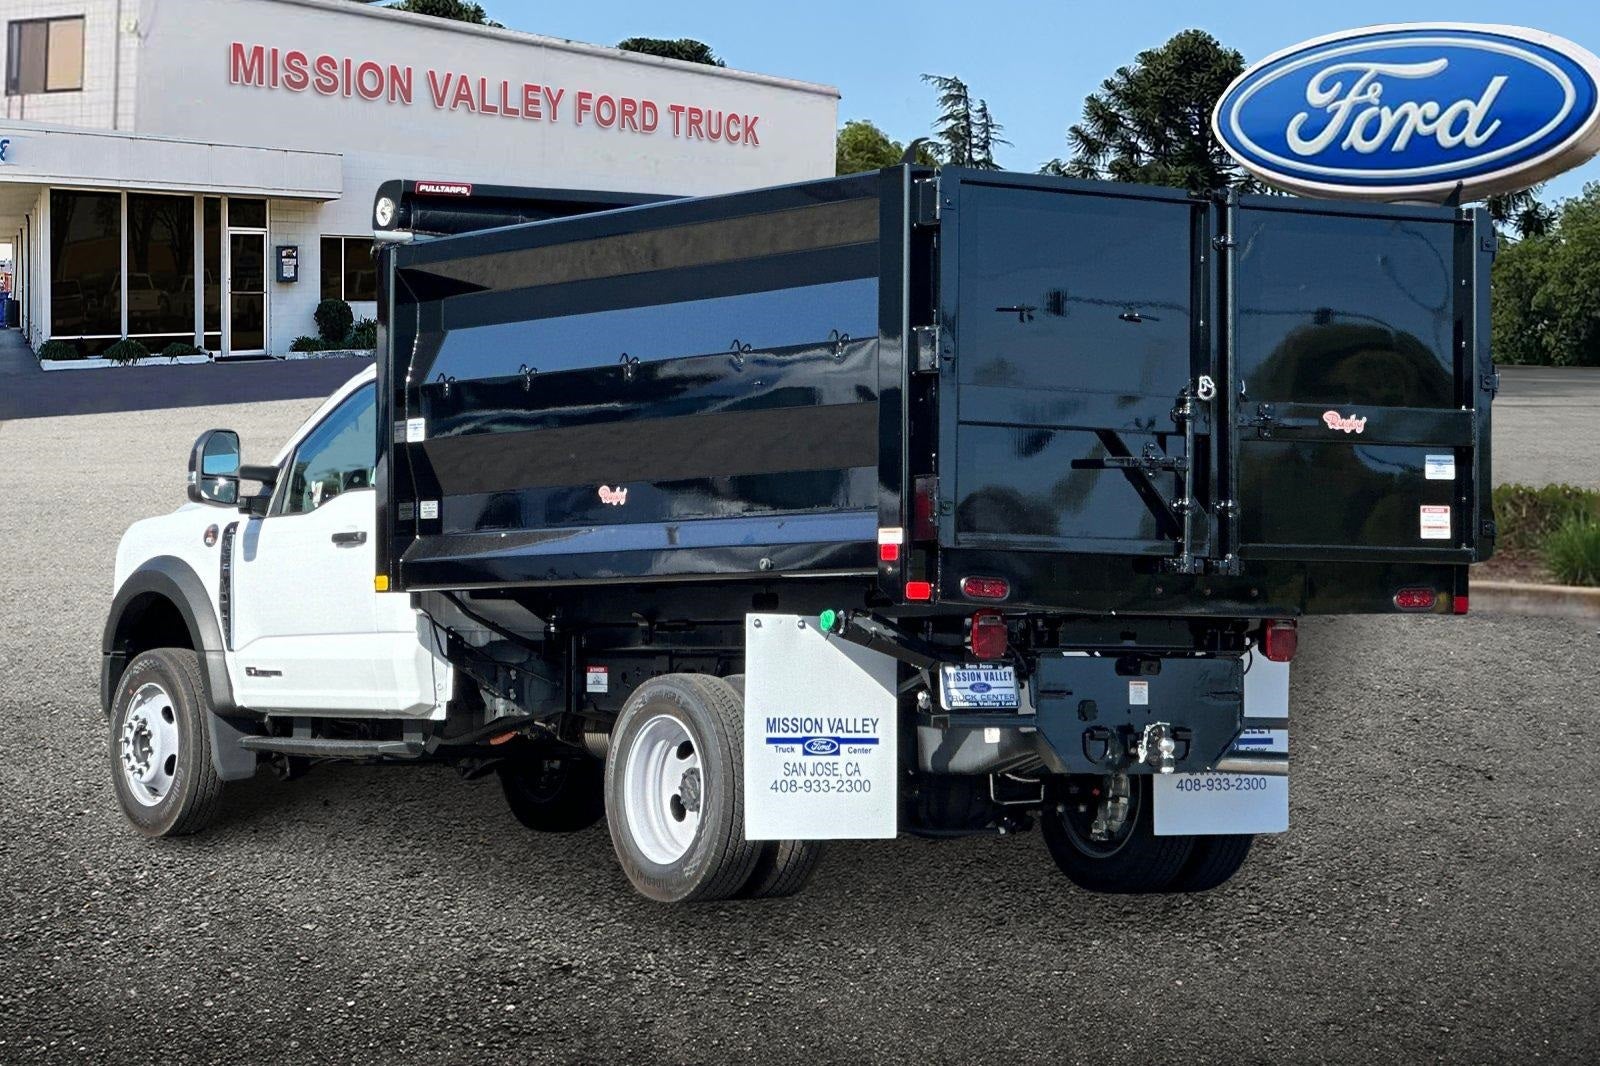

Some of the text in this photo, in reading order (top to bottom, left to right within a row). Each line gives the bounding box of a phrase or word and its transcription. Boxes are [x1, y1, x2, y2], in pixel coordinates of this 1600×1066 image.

[229, 41, 761, 146] MISSION VALLEY FORD TRUCK
[1286, 57, 1509, 157] Ford
[419, 184, 468, 194] PULLTARPS
[984, 671, 1013, 682] VALLEY
[980, 693, 1015, 701] CENTER
[766, 717, 880, 734] MISSION VALLEY
[810, 739, 833, 751] Ford
[847, 746, 872, 754] Center
[783, 762, 861, 778] SAN JOSE, CA
[769, 780, 871, 793] 408-933-2300
[1175, 777, 1267, 792] 408-933-2300
